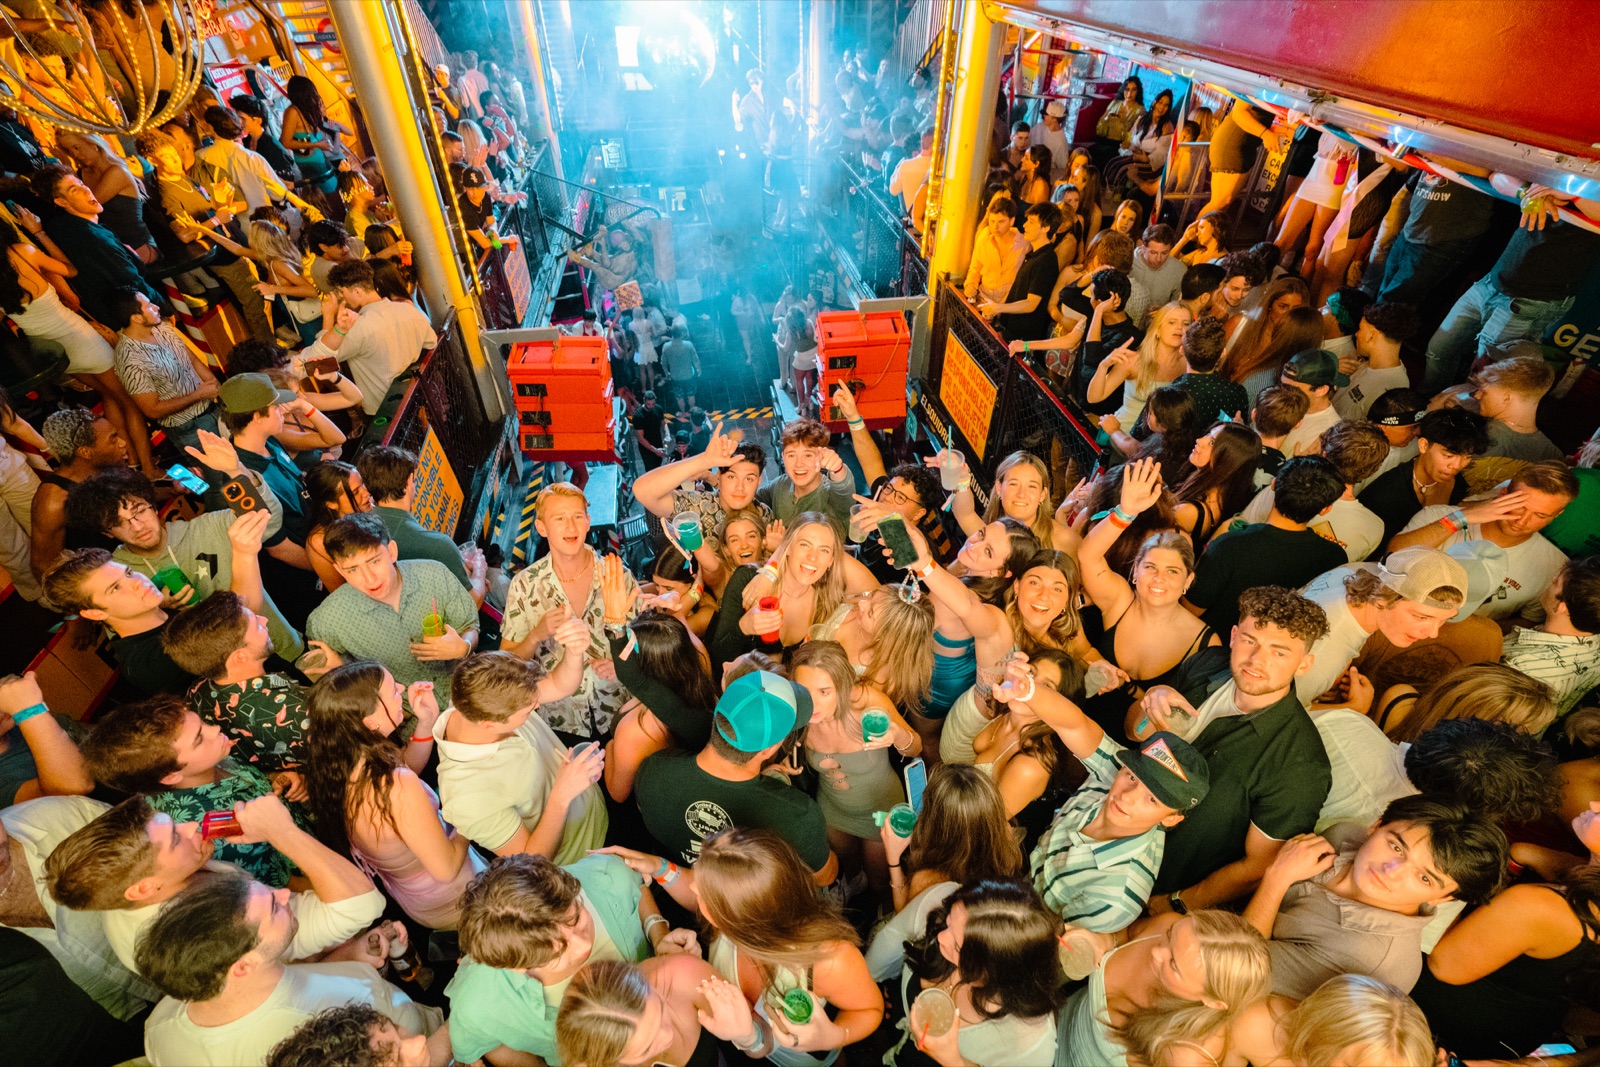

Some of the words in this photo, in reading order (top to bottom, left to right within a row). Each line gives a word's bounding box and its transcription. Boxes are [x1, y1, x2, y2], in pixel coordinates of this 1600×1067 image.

[946, 354, 987, 419] RESPONSABLES
[967, 364, 995, 405] HACEMOS
[944, 391, 979, 448] PERSONALES
[962, 399, 987, 440] OBJETOS
[421, 440, 434, 471] NOT
[413, 452, 441, 525] SPONSIBLE
[422, 513, 432, 530] OR
[429, 477, 443, 513] YOUR
[435, 492, 450, 532] SONAL
